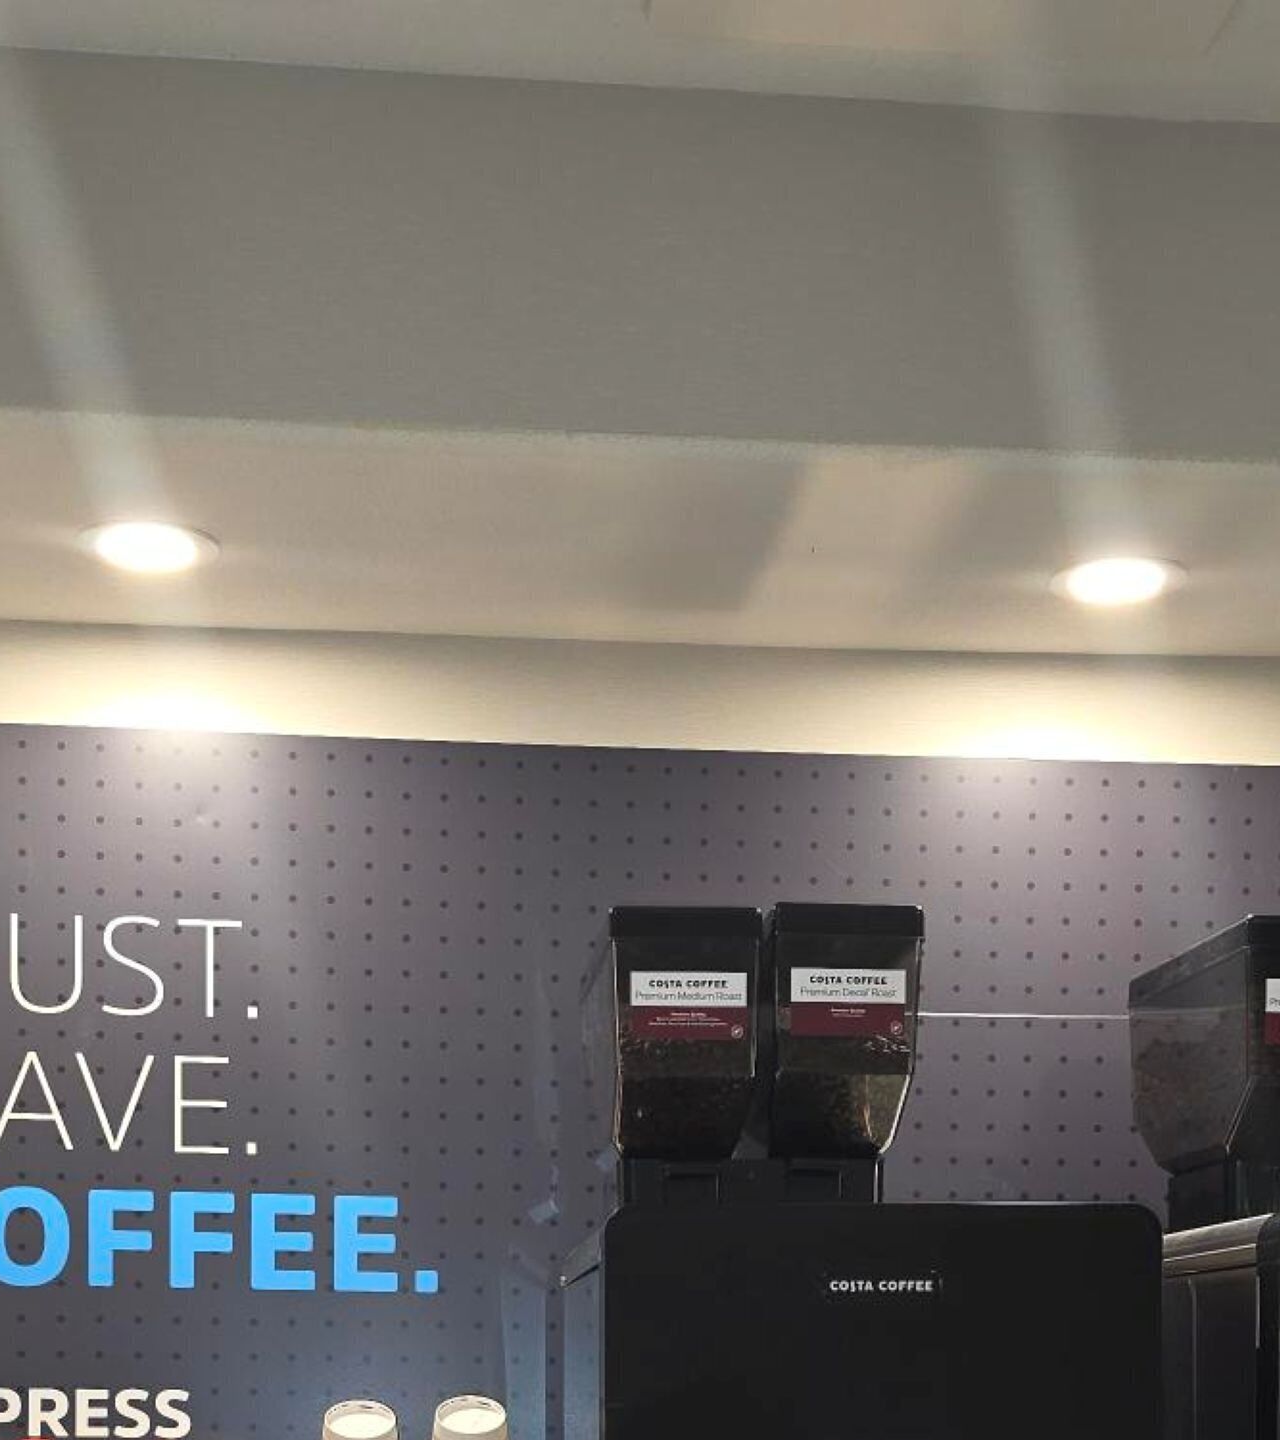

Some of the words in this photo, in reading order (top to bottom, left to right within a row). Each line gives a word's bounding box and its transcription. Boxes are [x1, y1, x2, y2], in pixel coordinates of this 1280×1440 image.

[648, 979, 682, 989] COSTA
[686, 980, 728, 989] COFFEE
[809, 976, 842, 985] COSTA
[846, 976, 888, 985] COFFEE
[829, 1280, 874, 1293] COSTA
[879, 1280, 934, 1292] COFFEE
